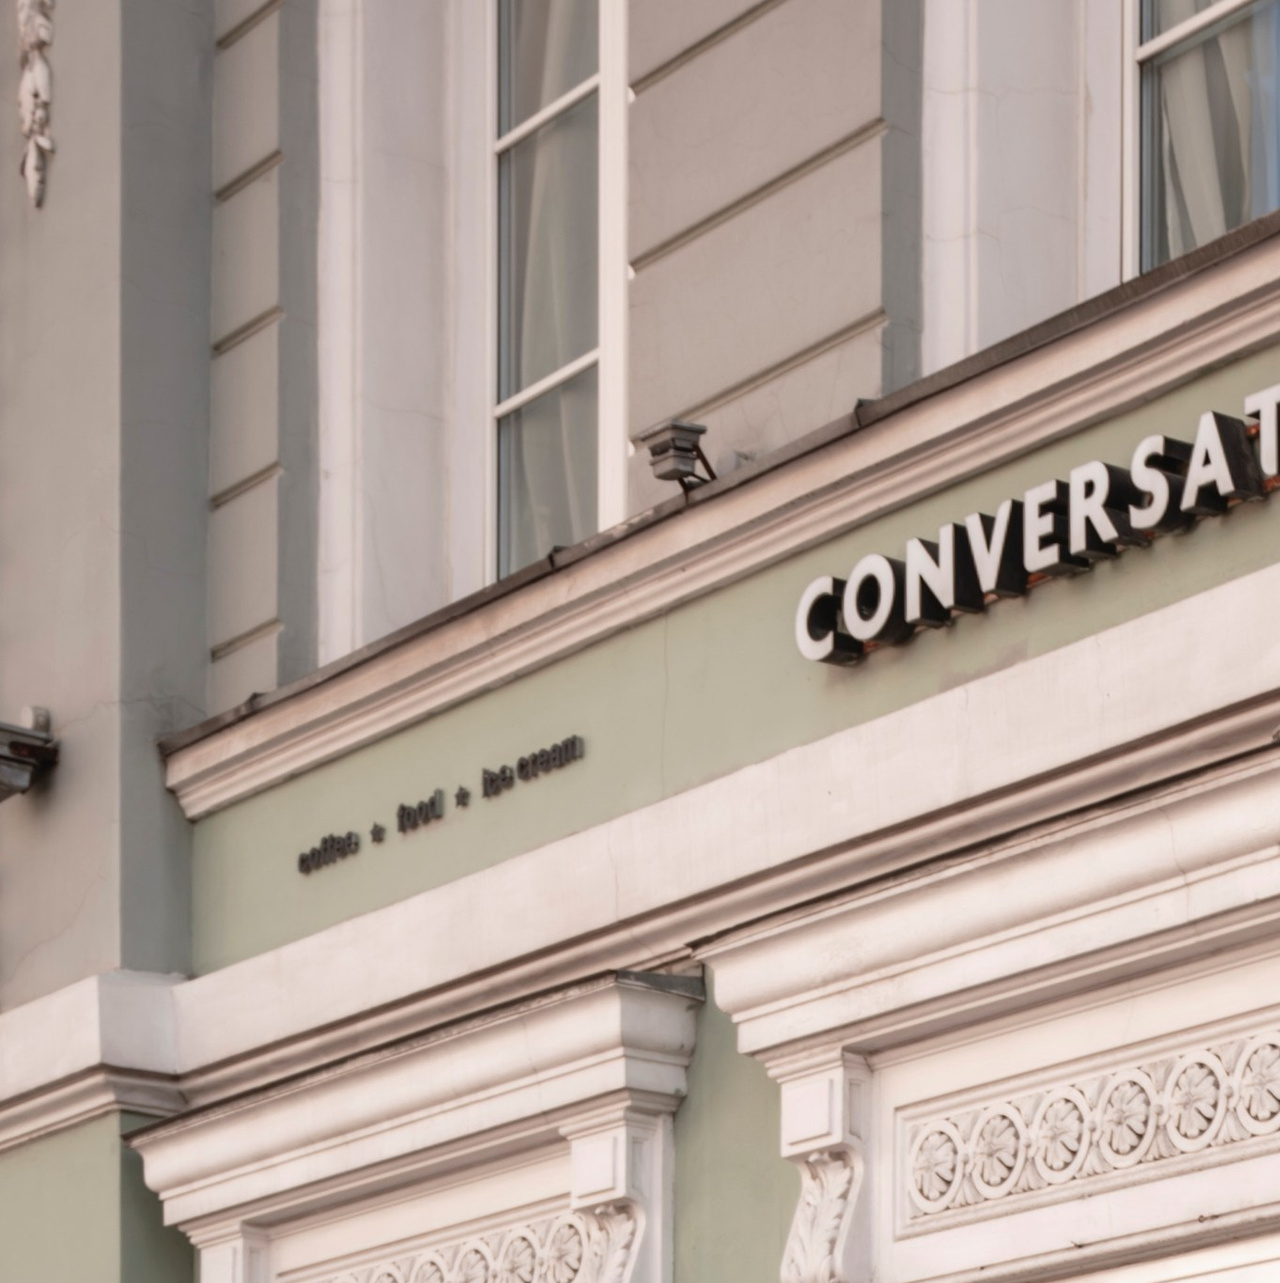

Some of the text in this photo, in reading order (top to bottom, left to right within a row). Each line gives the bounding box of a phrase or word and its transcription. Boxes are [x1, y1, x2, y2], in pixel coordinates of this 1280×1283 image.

[297, 734, 585, 875] coffee food ice cream
